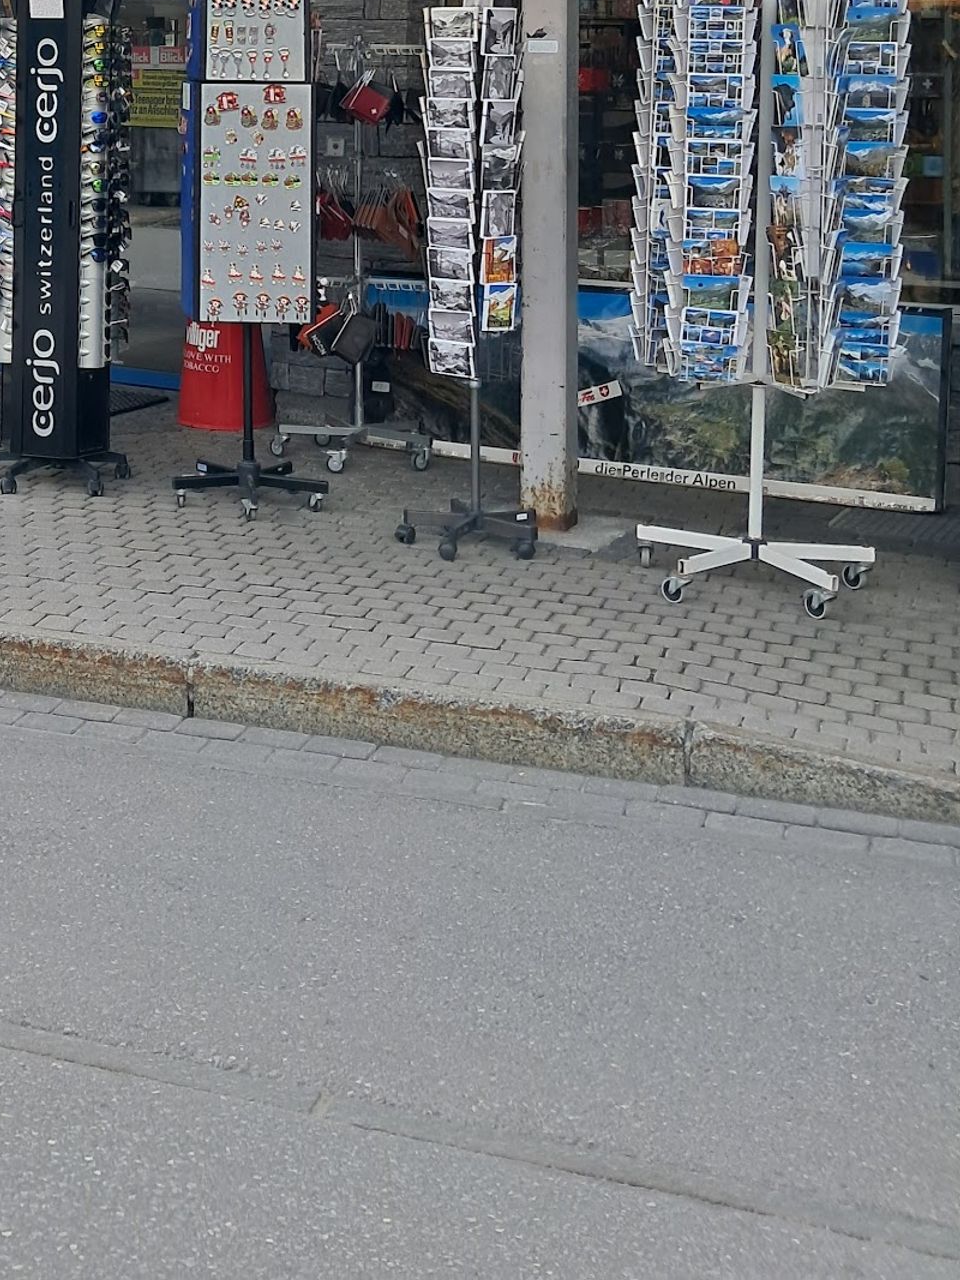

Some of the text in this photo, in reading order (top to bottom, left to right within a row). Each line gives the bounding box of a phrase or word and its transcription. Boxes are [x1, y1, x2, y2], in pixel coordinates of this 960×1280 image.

[133, 51, 149, 62] lick
[160, 51, 184, 62] Blick
[25, 37, 64, 437] cerjo switzerland cerjo
[204, 353, 232, 364] WITH
[594, 462, 736, 490] die Perle der Alpen
